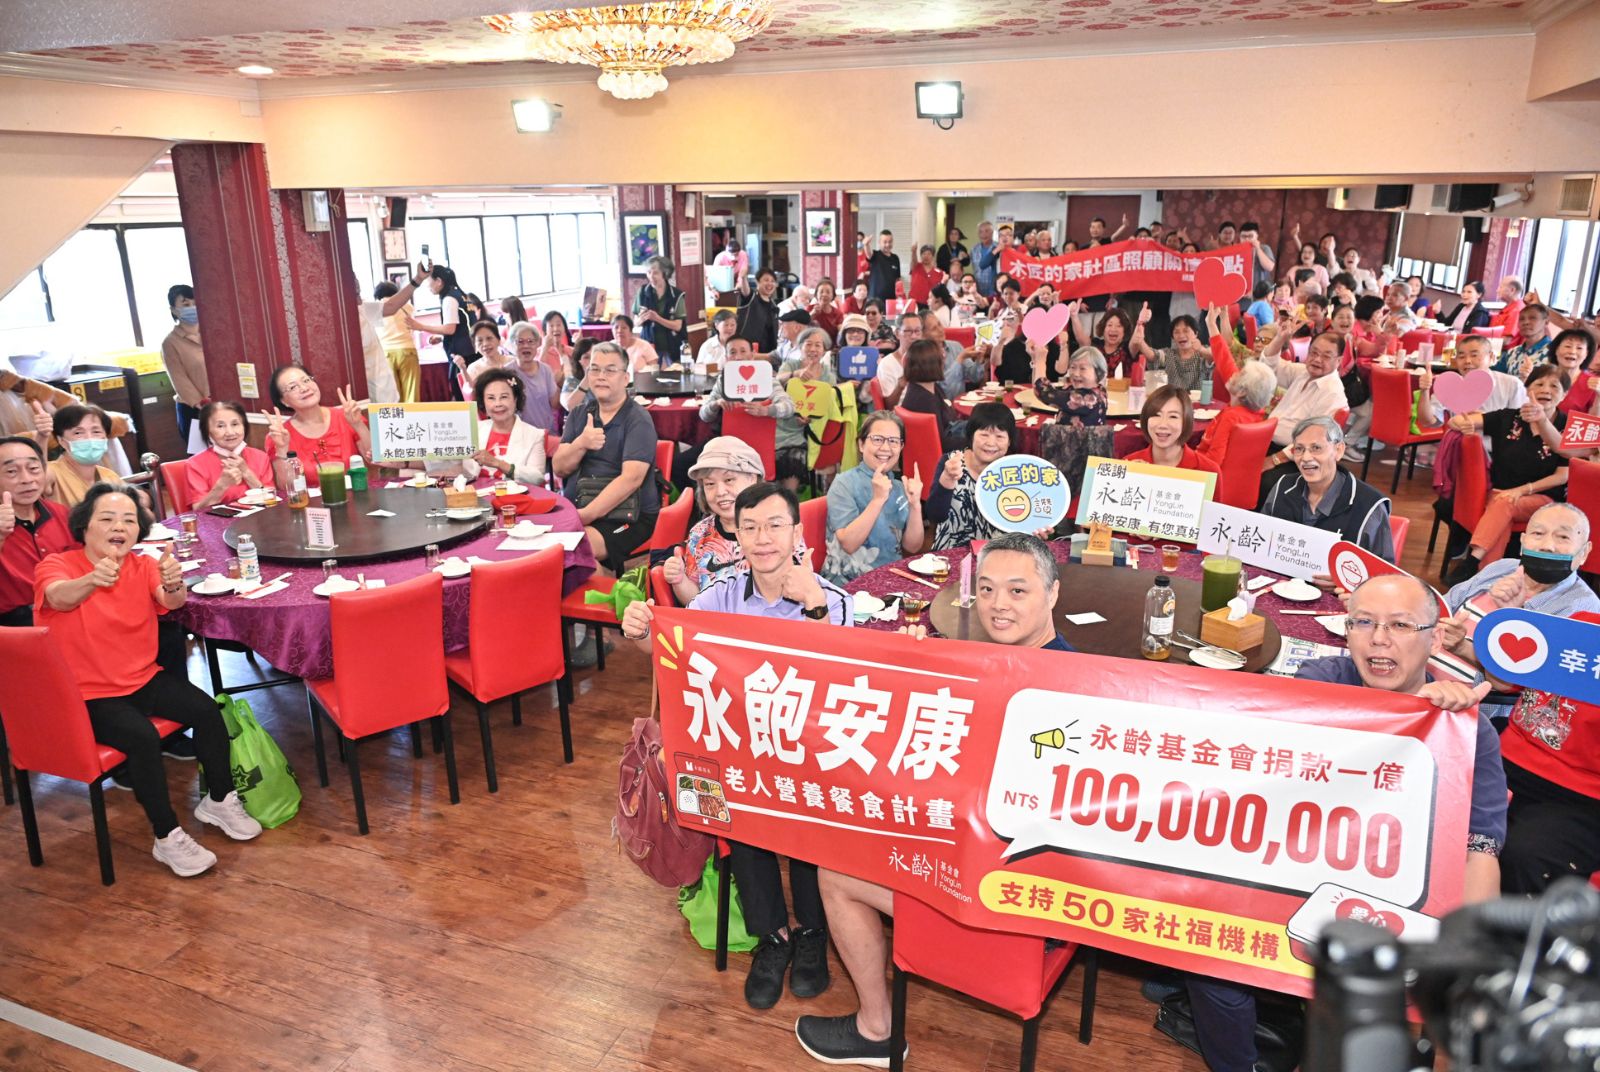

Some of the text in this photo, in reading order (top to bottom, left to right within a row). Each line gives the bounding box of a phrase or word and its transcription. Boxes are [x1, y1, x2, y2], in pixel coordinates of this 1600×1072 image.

[1009, 252, 1244, 283] 木匠的家社區照顧關懷點
[379, 407, 404, 419] 感謝
[385, 421, 425, 442] 永齡
[383, 446, 476, 459] 永飽安康 有您真好
[981, 464, 1061, 491] 木匠的家
[1096, 463, 1127, 479] 感謝
[1096, 482, 1146, 511] 永齡
[1155, 490, 1182, 501] 基金會
[1089, 511, 1200, 539] 永飽安康 有您真好
[1152, 508, 1195, 520] Foundation
[1210, 517, 1266, 553] 永齡
[1277, 533, 1307, 548] 基金會
[1274, 552, 1322, 571] Foundation
[682, 651, 975, 780] 永飽安康
[1090, 723, 1406, 793] 永齡基金會捐款一億
[724, 765, 956, 830] 老人營養餐食計畫
[1003, 763, 1403, 879] NT$ 100,000,000
[888, 846, 934, 883] 永齡
[939, 881, 973, 904] Foundation
